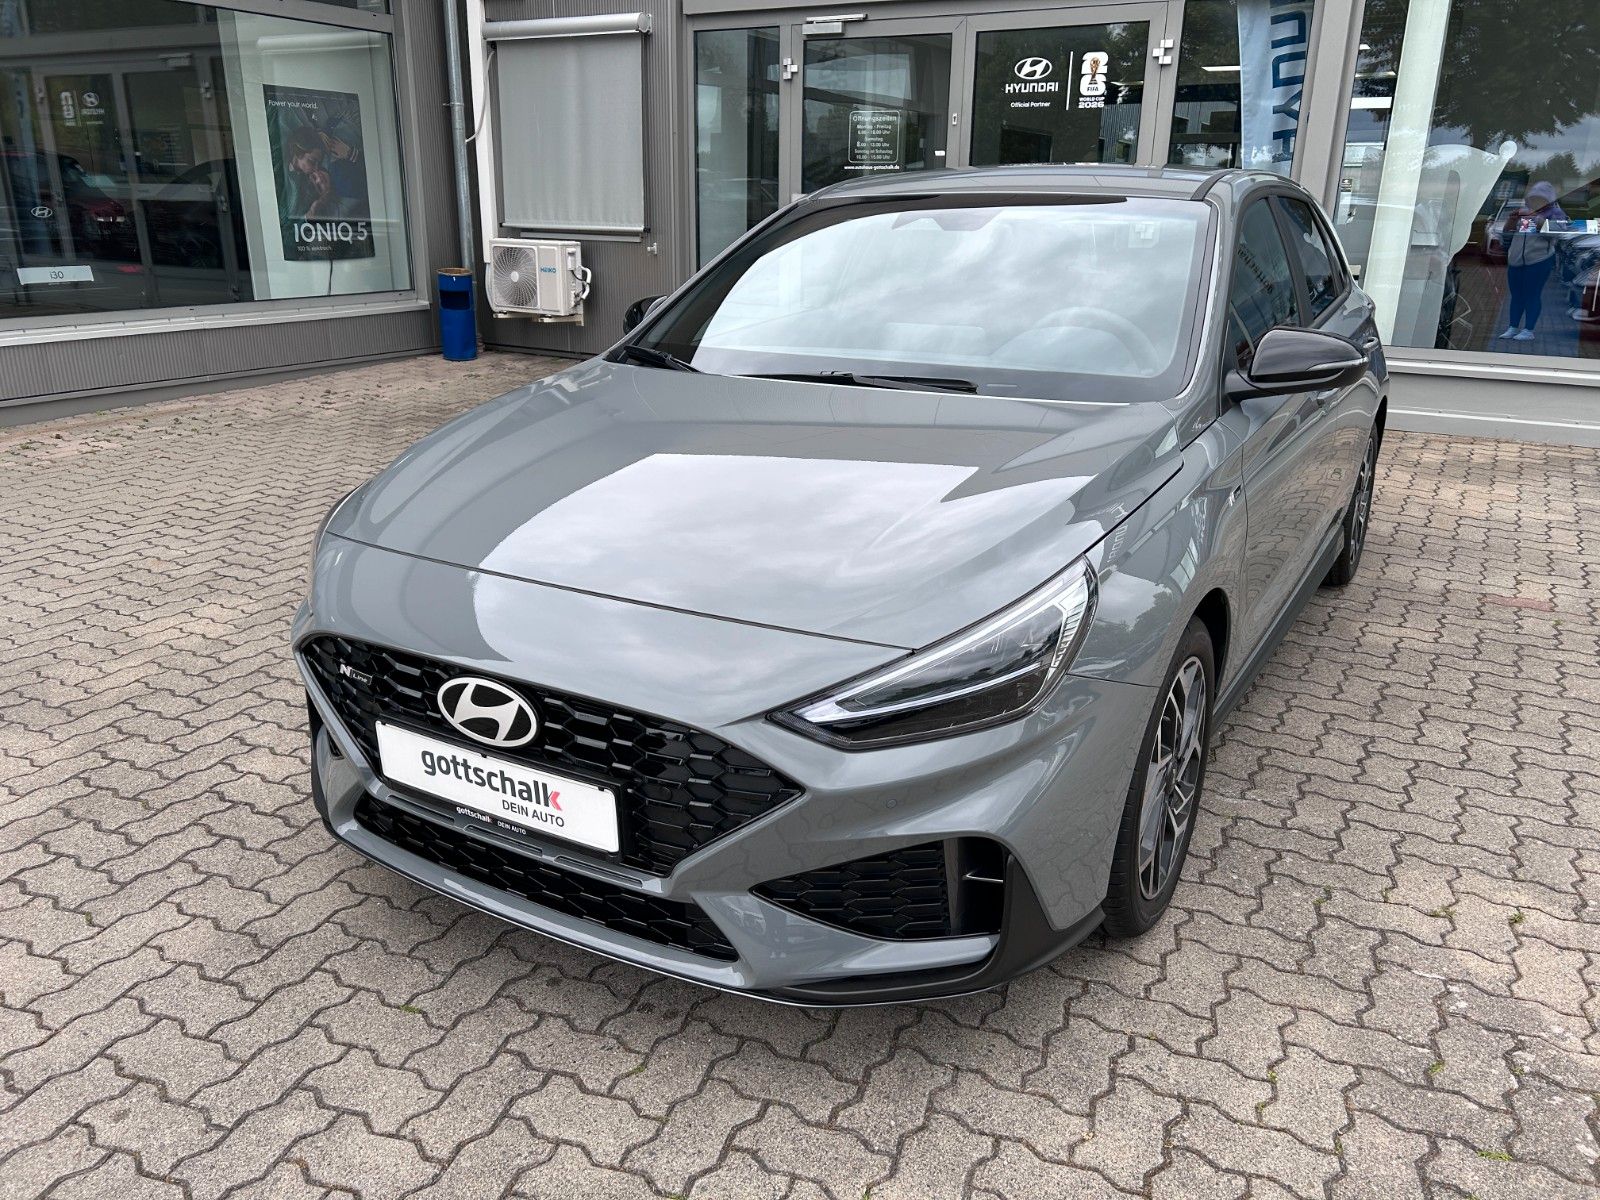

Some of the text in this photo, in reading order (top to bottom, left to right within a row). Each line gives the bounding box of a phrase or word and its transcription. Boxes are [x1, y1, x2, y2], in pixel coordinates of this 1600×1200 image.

[1005, 82, 1059, 94] HYUNDAI
[268, 99, 286, 107] Power
[301, 101, 319, 109] world.
[852, 114, 897, 122] Öffnungszeiten
[294, 221, 368, 245] IONIQ 5
[50, 270, 65, 280] i30
[340, 663, 352, 678] N
[421, 750, 563, 812] gottschalk
[456, 806, 527, 835] gottschalk DEIN AUTO
[502, 799, 566, 828] DEIN AUTO
